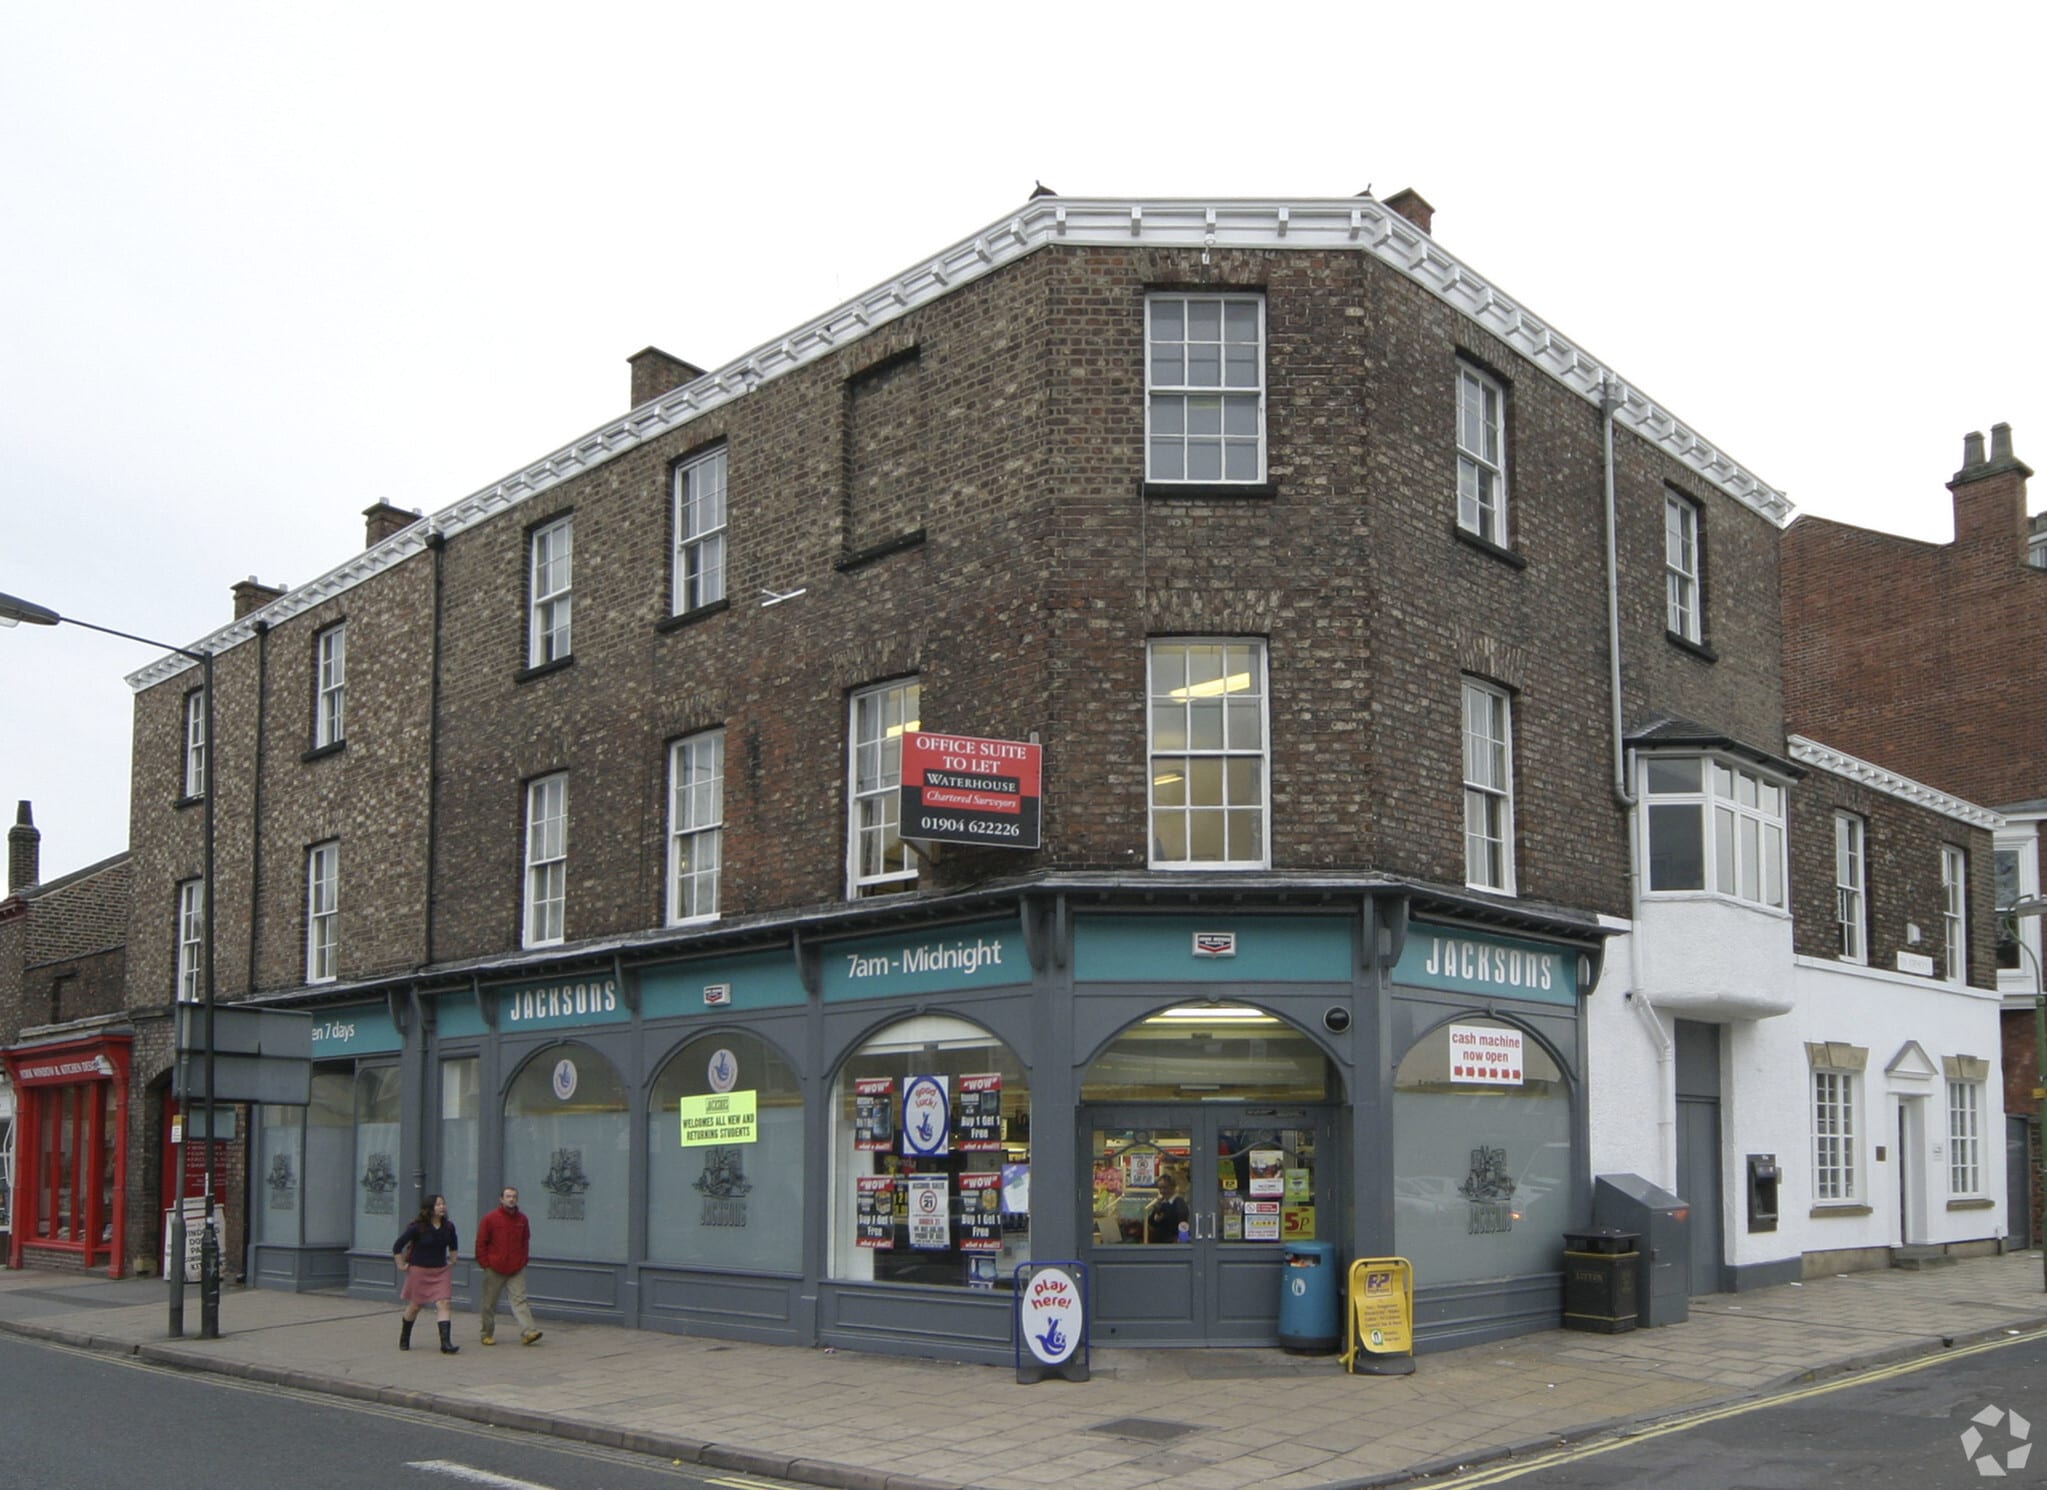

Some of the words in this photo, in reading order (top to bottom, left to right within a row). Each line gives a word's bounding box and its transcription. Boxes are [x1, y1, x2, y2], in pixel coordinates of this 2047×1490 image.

[916, 736, 975, 754] OFFICE
[980, 742, 1027, 760] SUITE
[943, 756, 967, 770] TO
[972, 759, 1001, 773] LET
[926, 772, 1017, 793] WATERHOUSE
[926, 790, 972, 805] Chartered
[974, 794, 1016, 809] Surveyors
[921, 816, 964, 832] 01904
[968, 820, 1020, 837] 622226
[847, 953, 888, 978] 7am
[902, 939, 1002, 974] Midnight
[1426, 937, 1551, 990] JACKSONS
[510, 980, 616, 1021] JACKSONS
[325, 1023, 331, 1040] 7
[332, 1020, 355, 1042] days
[1452, 1031, 1476, 1045] cash
[1479, 1034, 1521, 1049] machine
[1463, 1051, 1483, 1061] now
[1486, 1051, 1509, 1064] open
[683, 1117, 714, 1128] WELCOMES
[715, 1115, 726, 1126] ALL
[728, 1115, 741, 1125] NEW
[742, 1113, 754, 1124] AND
[687, 1129, 718, 1141] RETURNING
[720, 1127, 751, 1139] STUDENTS
[1034, 1279, 1068, 1296] play
[1031, 1296, 1073, 1310] here!
